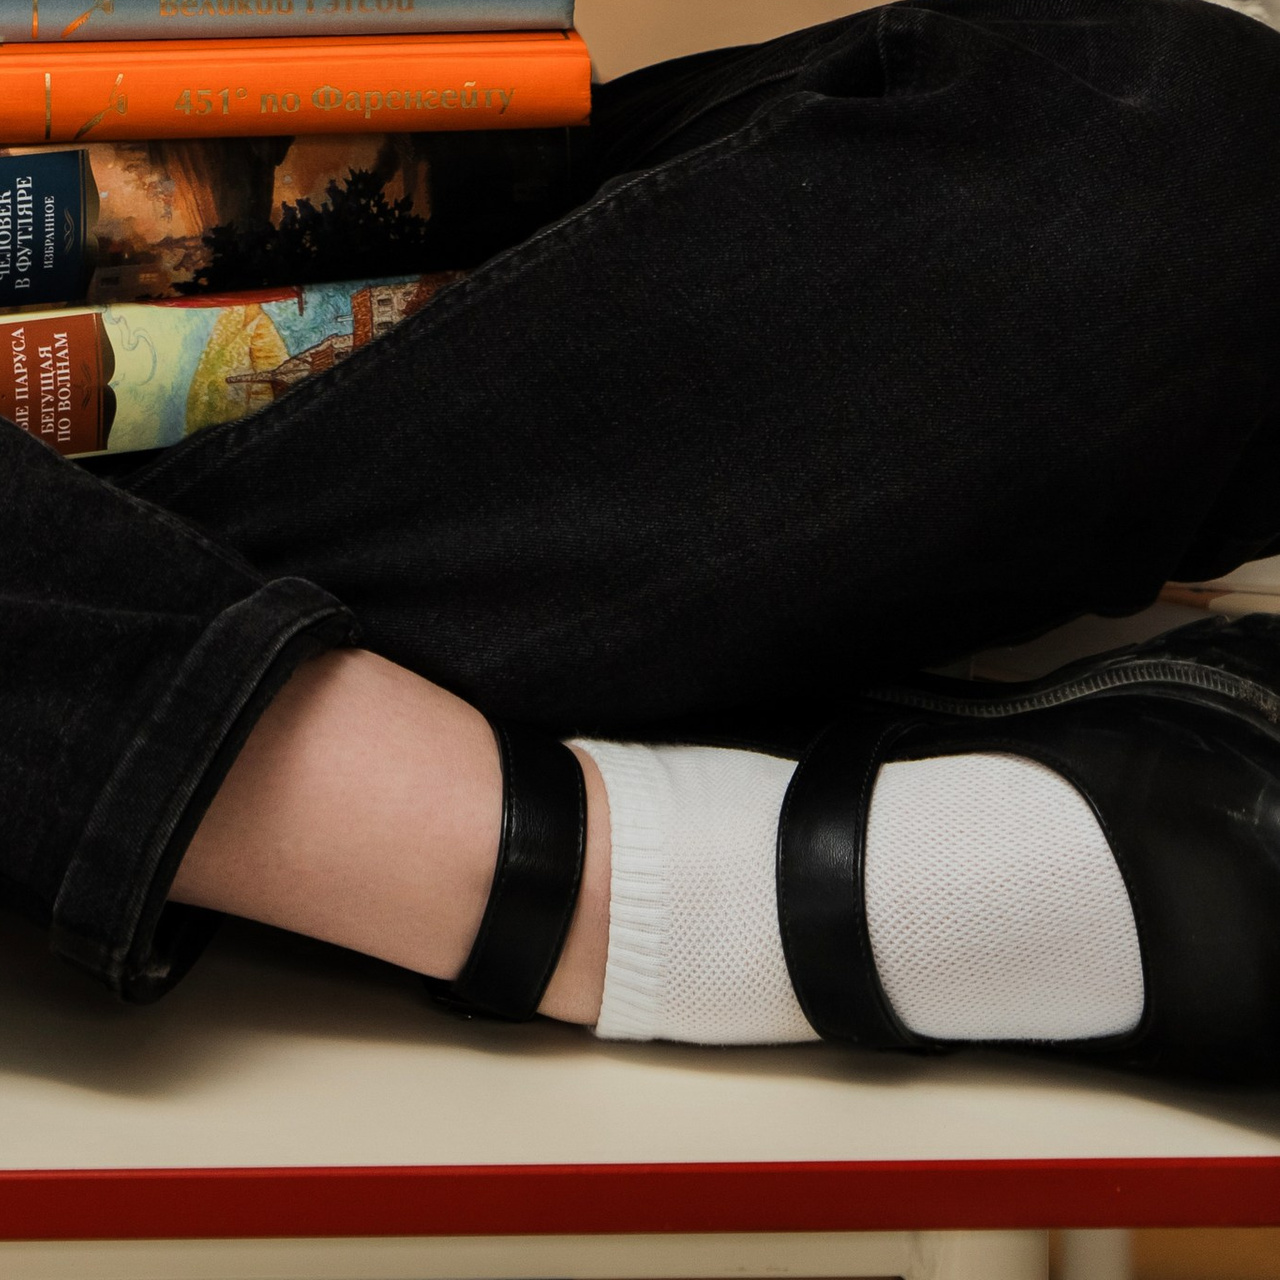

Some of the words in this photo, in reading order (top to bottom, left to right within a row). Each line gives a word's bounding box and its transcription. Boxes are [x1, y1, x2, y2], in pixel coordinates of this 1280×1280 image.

[174, 87, 248, 116] 451°
[260, 91, 301, 114] по
[311, 81, 516, 119] Фаренгейту
[15, 176, 33, 273] ФУТЛЯРЕ
[43, 195, 55, 269] ИЗБРАННОЕ
[15, 277, 31, 290] В
[11, 327, 29, 400] ПАРУСА
[38, 345, 56, 434] БЕГУЩАЯ
[54, 331, 72, 411] ВОЛНАМ
[57, 418, 72, 442] ПО
